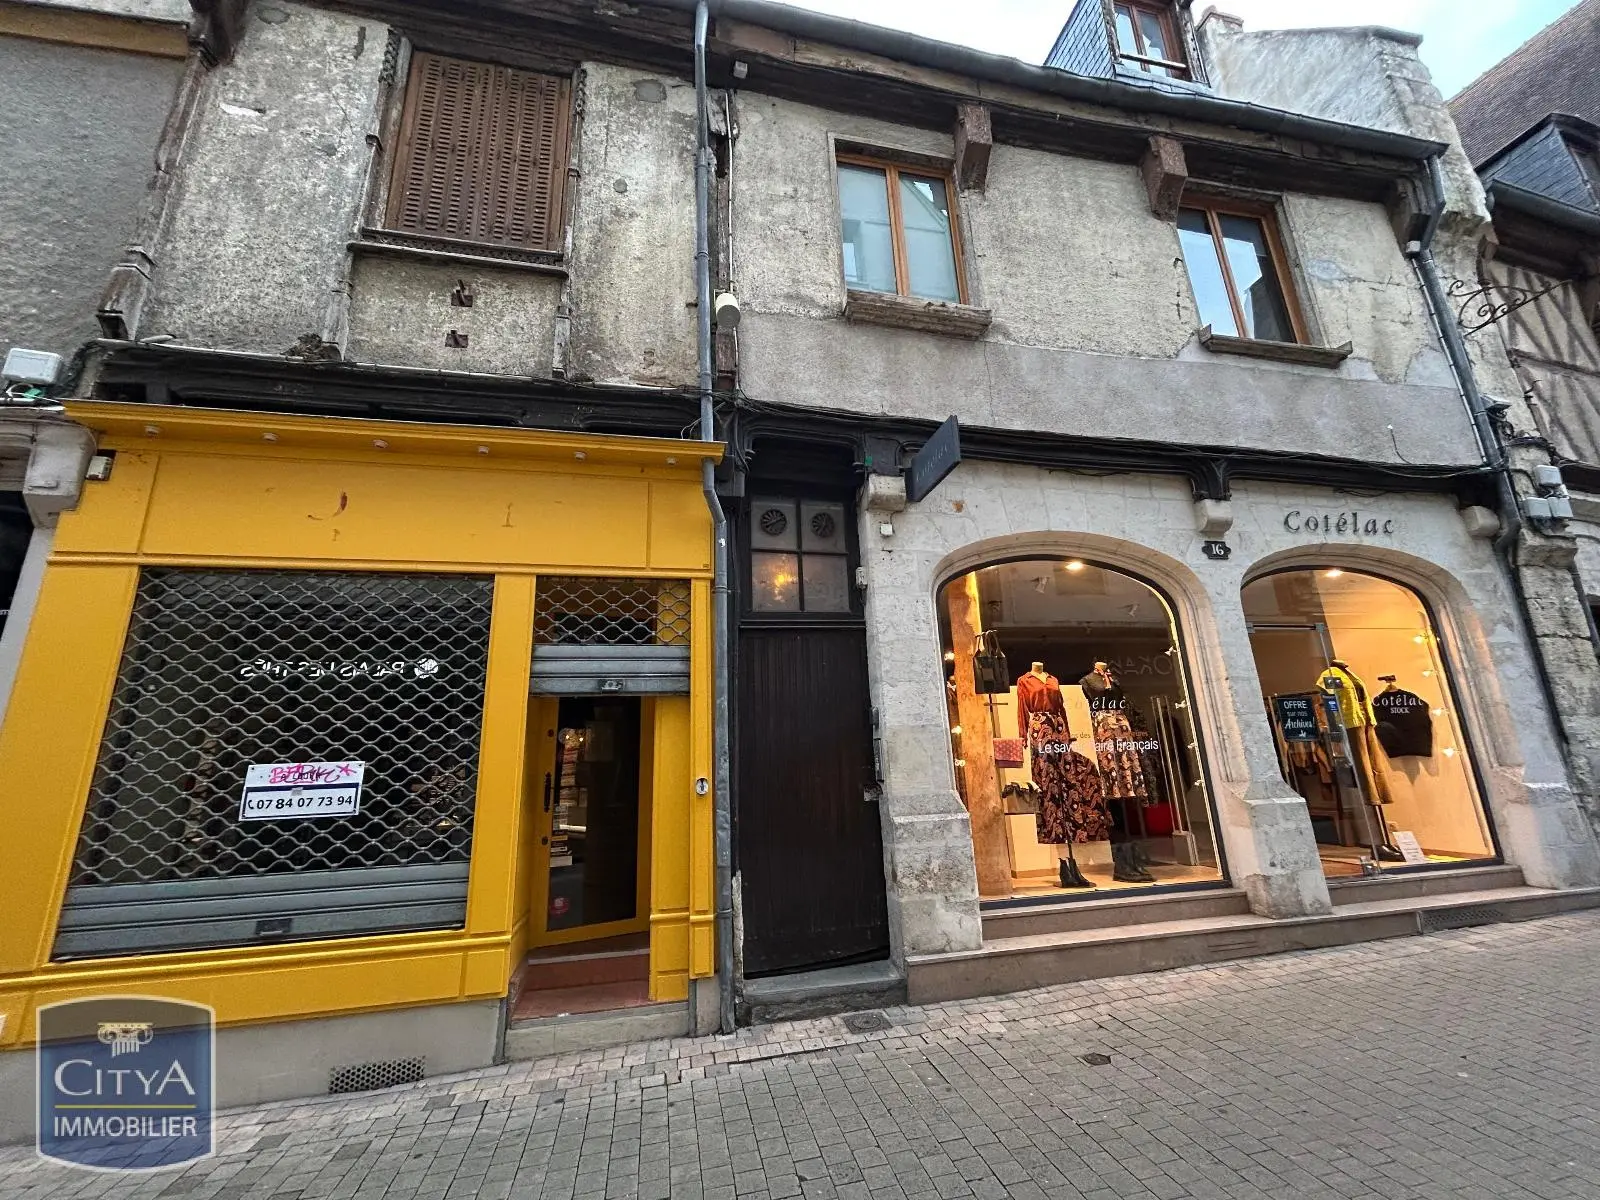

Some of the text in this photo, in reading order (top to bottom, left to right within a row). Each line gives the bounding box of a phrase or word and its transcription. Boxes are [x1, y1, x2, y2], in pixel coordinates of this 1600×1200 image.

[1284, 511, 1394, 535] Cotélac
[1211, 543, 1224, 555] 16
[1283, 700, 1308, 709] OFFRE
[1390, 706, 1410, 714] STOCK
[256, 796, 353, 810] 07 84 07 73 94
